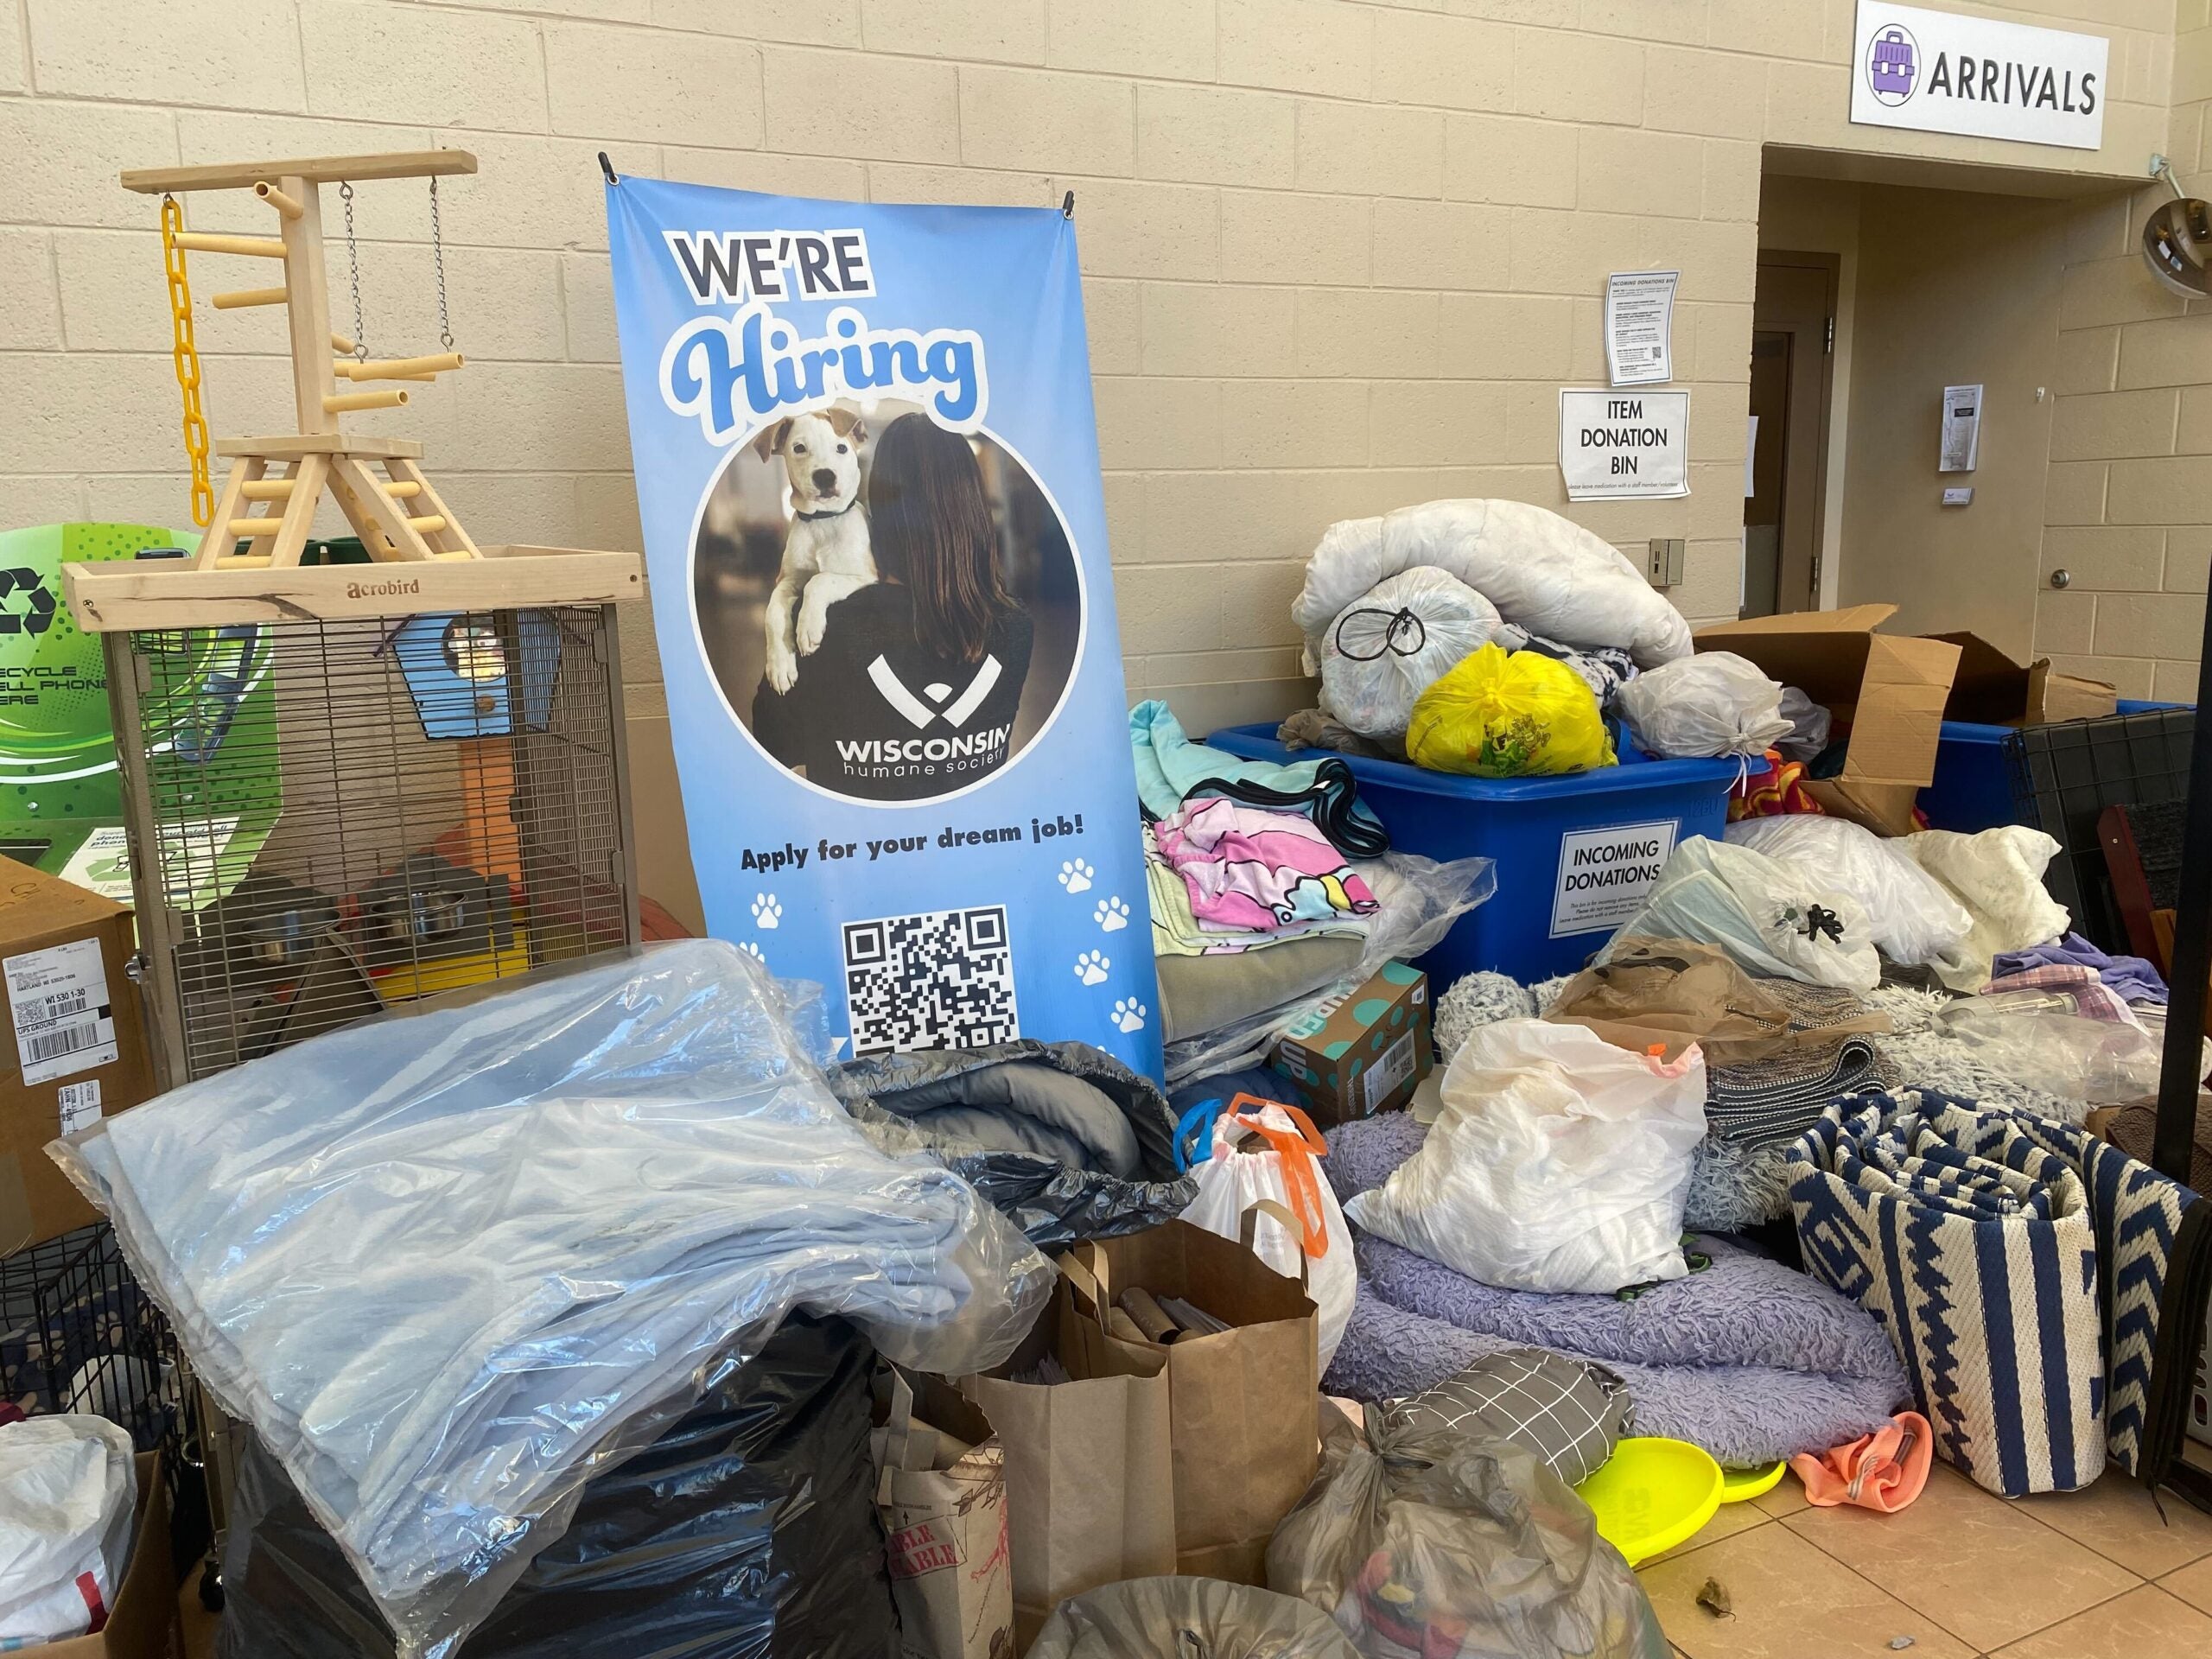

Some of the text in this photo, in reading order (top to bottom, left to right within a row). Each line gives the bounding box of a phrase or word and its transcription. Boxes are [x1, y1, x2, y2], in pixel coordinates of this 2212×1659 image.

[1927, 51, 2096, 115] ARRIVALS
[672, 236, 869, 298] WE'RE
[671, 312, 978, 435] Hiring
[1607, 400, 1643, 419] ITEM
[1580, 428, 1668, 448] DONATION
[1611, 456, 1638, 474] BIN
[346, 578, 420, 599] acrobird
[835, 723, 1011, 763] WISCONSIN
[843, 761, 936, 779] humane
[741, 814, 1084, 874] Apply for your dream job!
[1573, 840, 1659, 867] INCOMING
[1565, 863, 1661, 892] DONATIONS
[45, 988, 86, 1005] WI 530 1-30
[31, 1020, 57, 1032] GROUND
